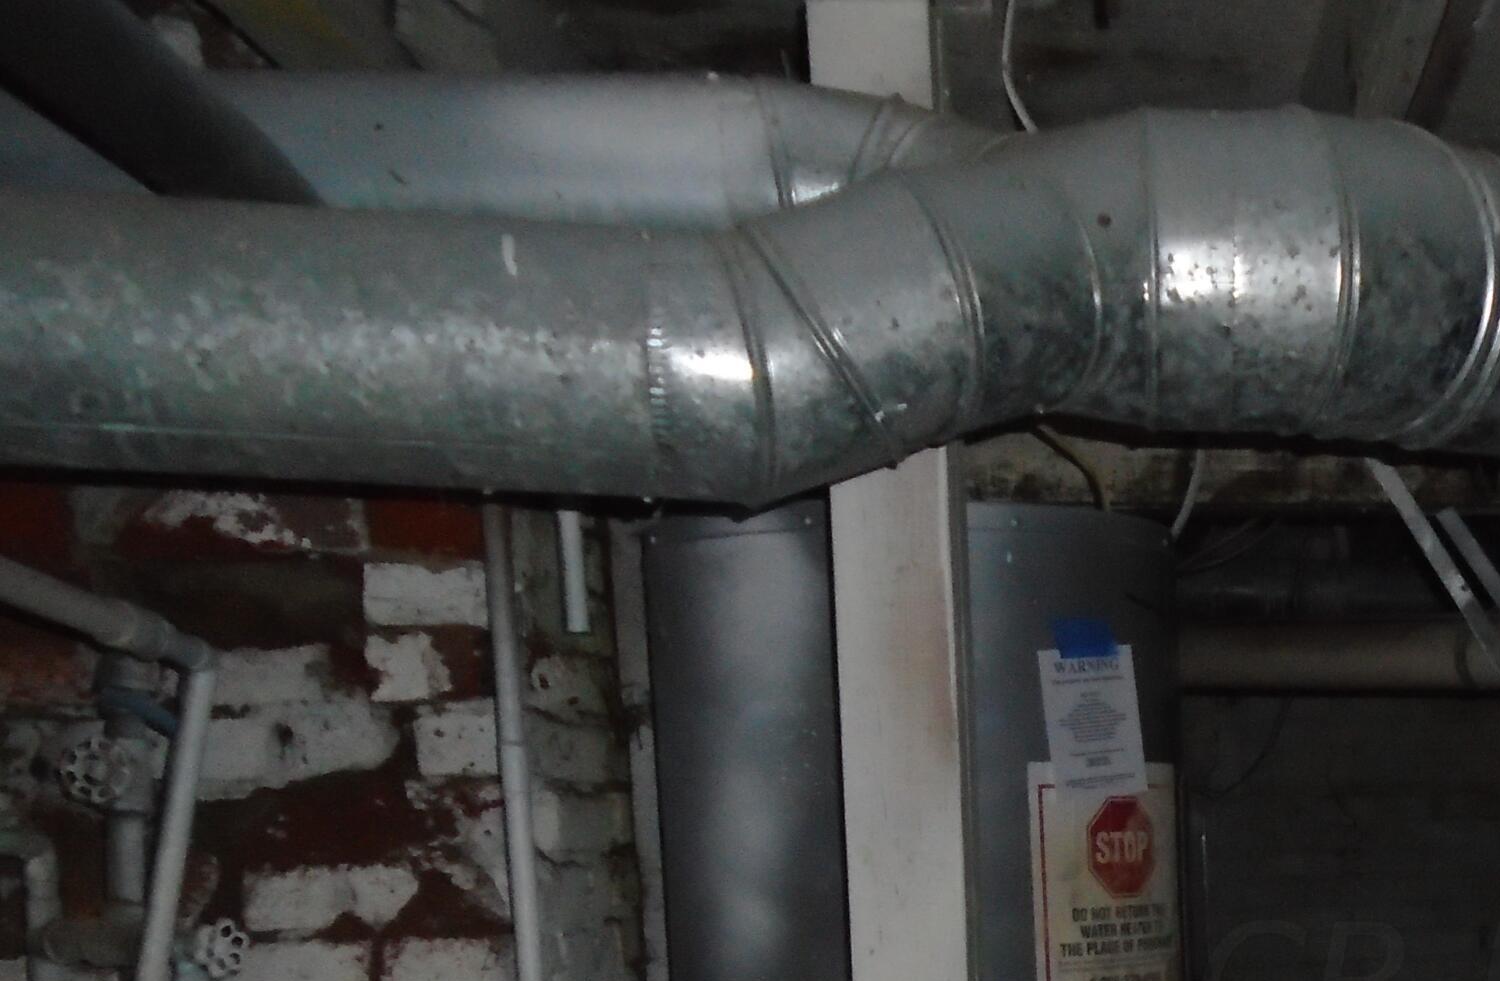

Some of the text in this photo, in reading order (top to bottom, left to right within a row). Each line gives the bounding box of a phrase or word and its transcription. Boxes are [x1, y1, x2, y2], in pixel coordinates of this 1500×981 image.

[1053, 659, 1120, 674] WARNING
[1095, 832, 1149, 865] STOP
[1072, 907, 1088, 922] DO
[1080, 923, 1118, 938] WATER
[1060, 942, 1083, 957] THE
[1086, 940, 1120, 956] PLACE
